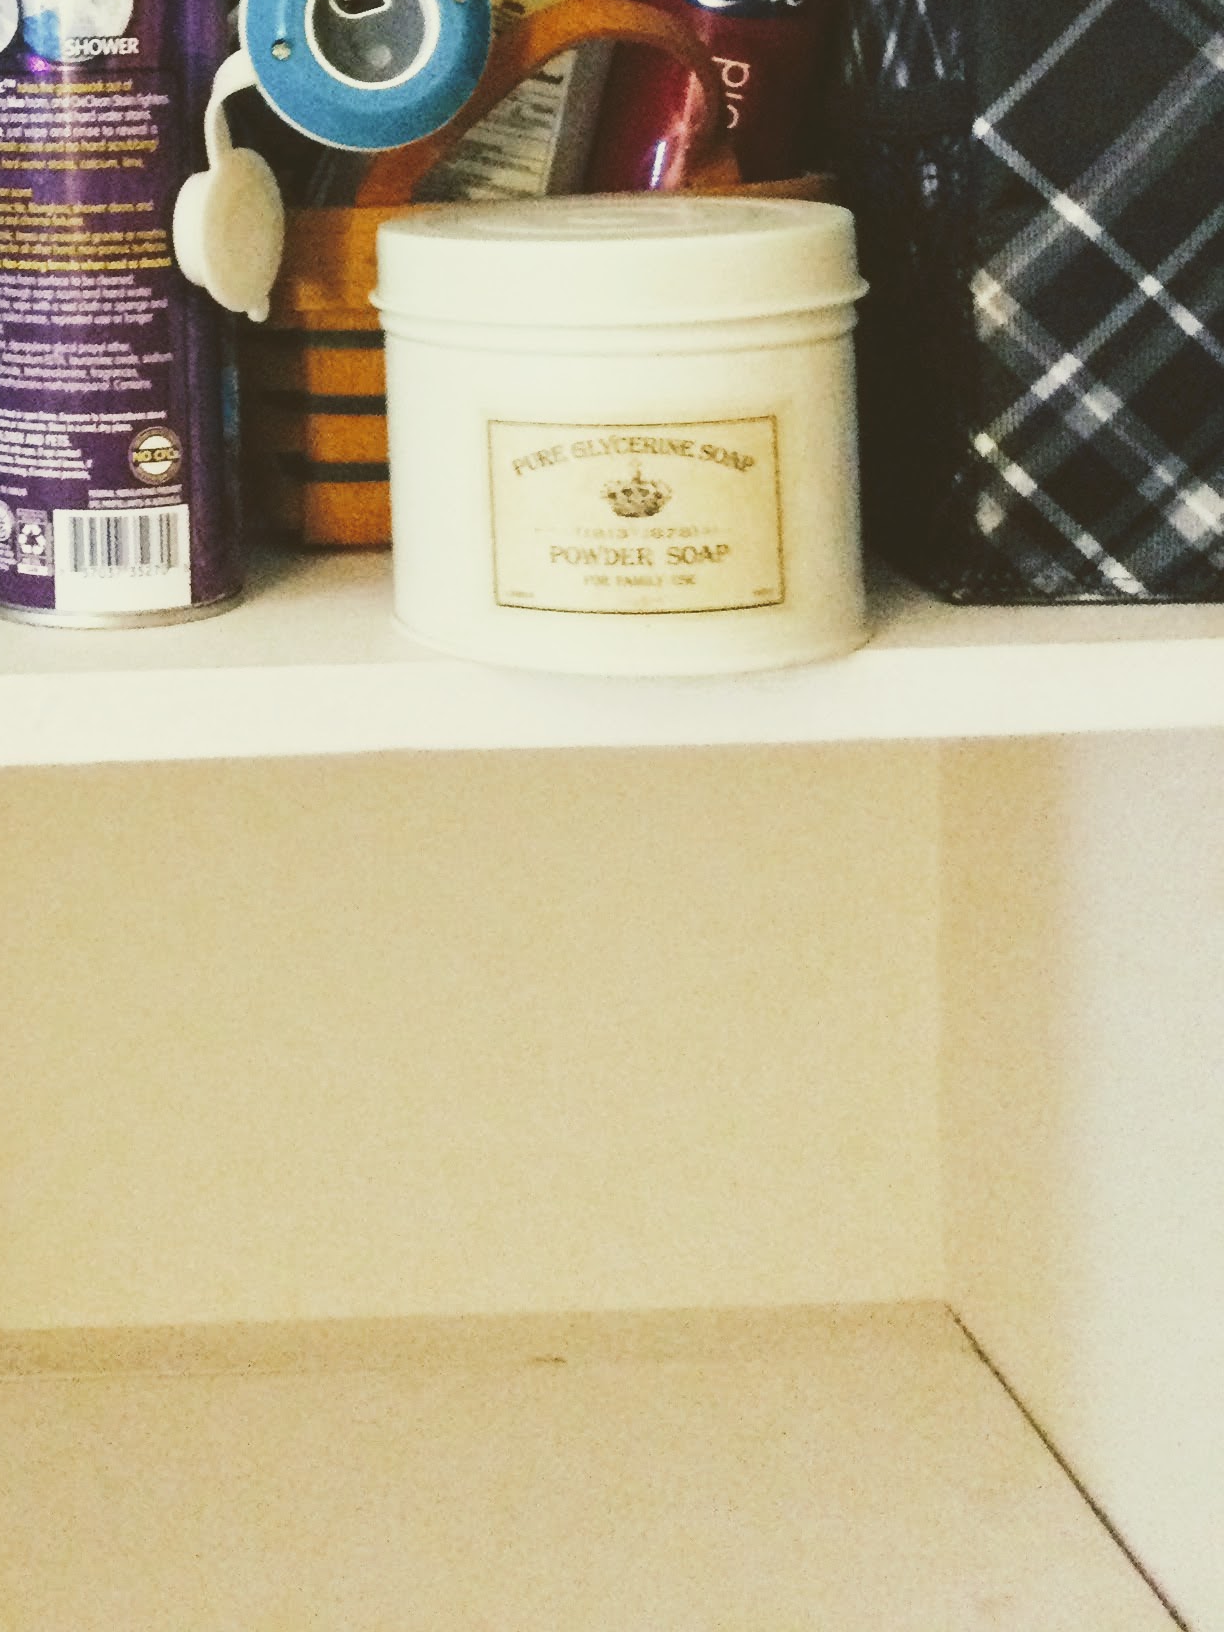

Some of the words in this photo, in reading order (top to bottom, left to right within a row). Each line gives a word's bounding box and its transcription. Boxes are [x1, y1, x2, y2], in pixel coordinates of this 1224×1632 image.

[62, 37, 140, 56] SHOWER
[511, 443, 568, 477] PURE
[570, 433, 696, 459] GLYCERINE
[697, 443, 755, 473] SOAP
[549, 544, 653, 566] POWDER
[666, 542, 730, 566] SOAP
[583, 573, 610, 587] FOR
[615, 573, 664, 588] FAMILY
